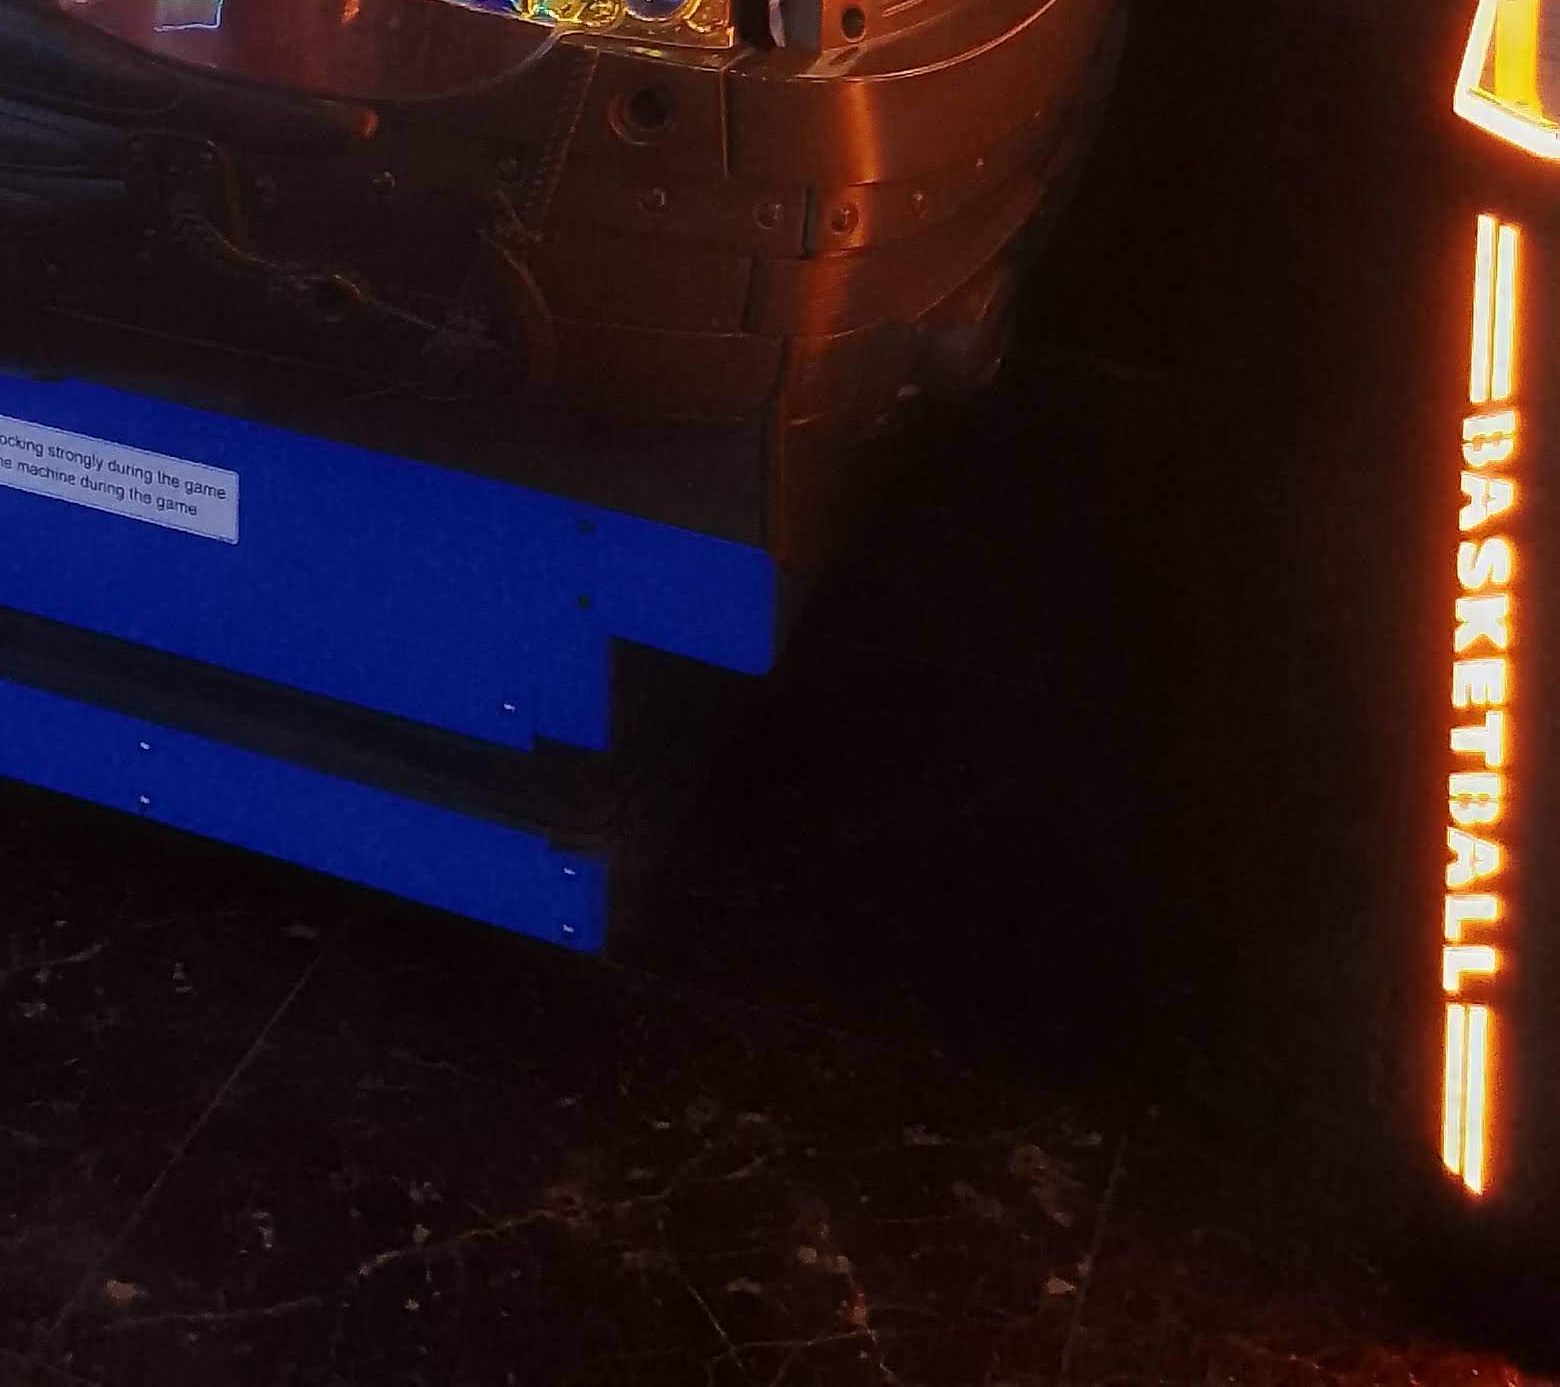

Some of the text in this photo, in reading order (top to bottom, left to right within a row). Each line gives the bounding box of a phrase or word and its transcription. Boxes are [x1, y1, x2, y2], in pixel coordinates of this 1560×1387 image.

[17, 461, 76, 486] machine
[80, 476, 126, 501] during
[129, 487, 152, 505] the
[156, 495, 198, 517] game
[48, 445, 104, 471] strongly
[108, 460, 154, 485] during
[157, 470, 180, 489] the
[184, 479, 228, 500] game
[1442, 409, 1515, 993] BASKETBALL
